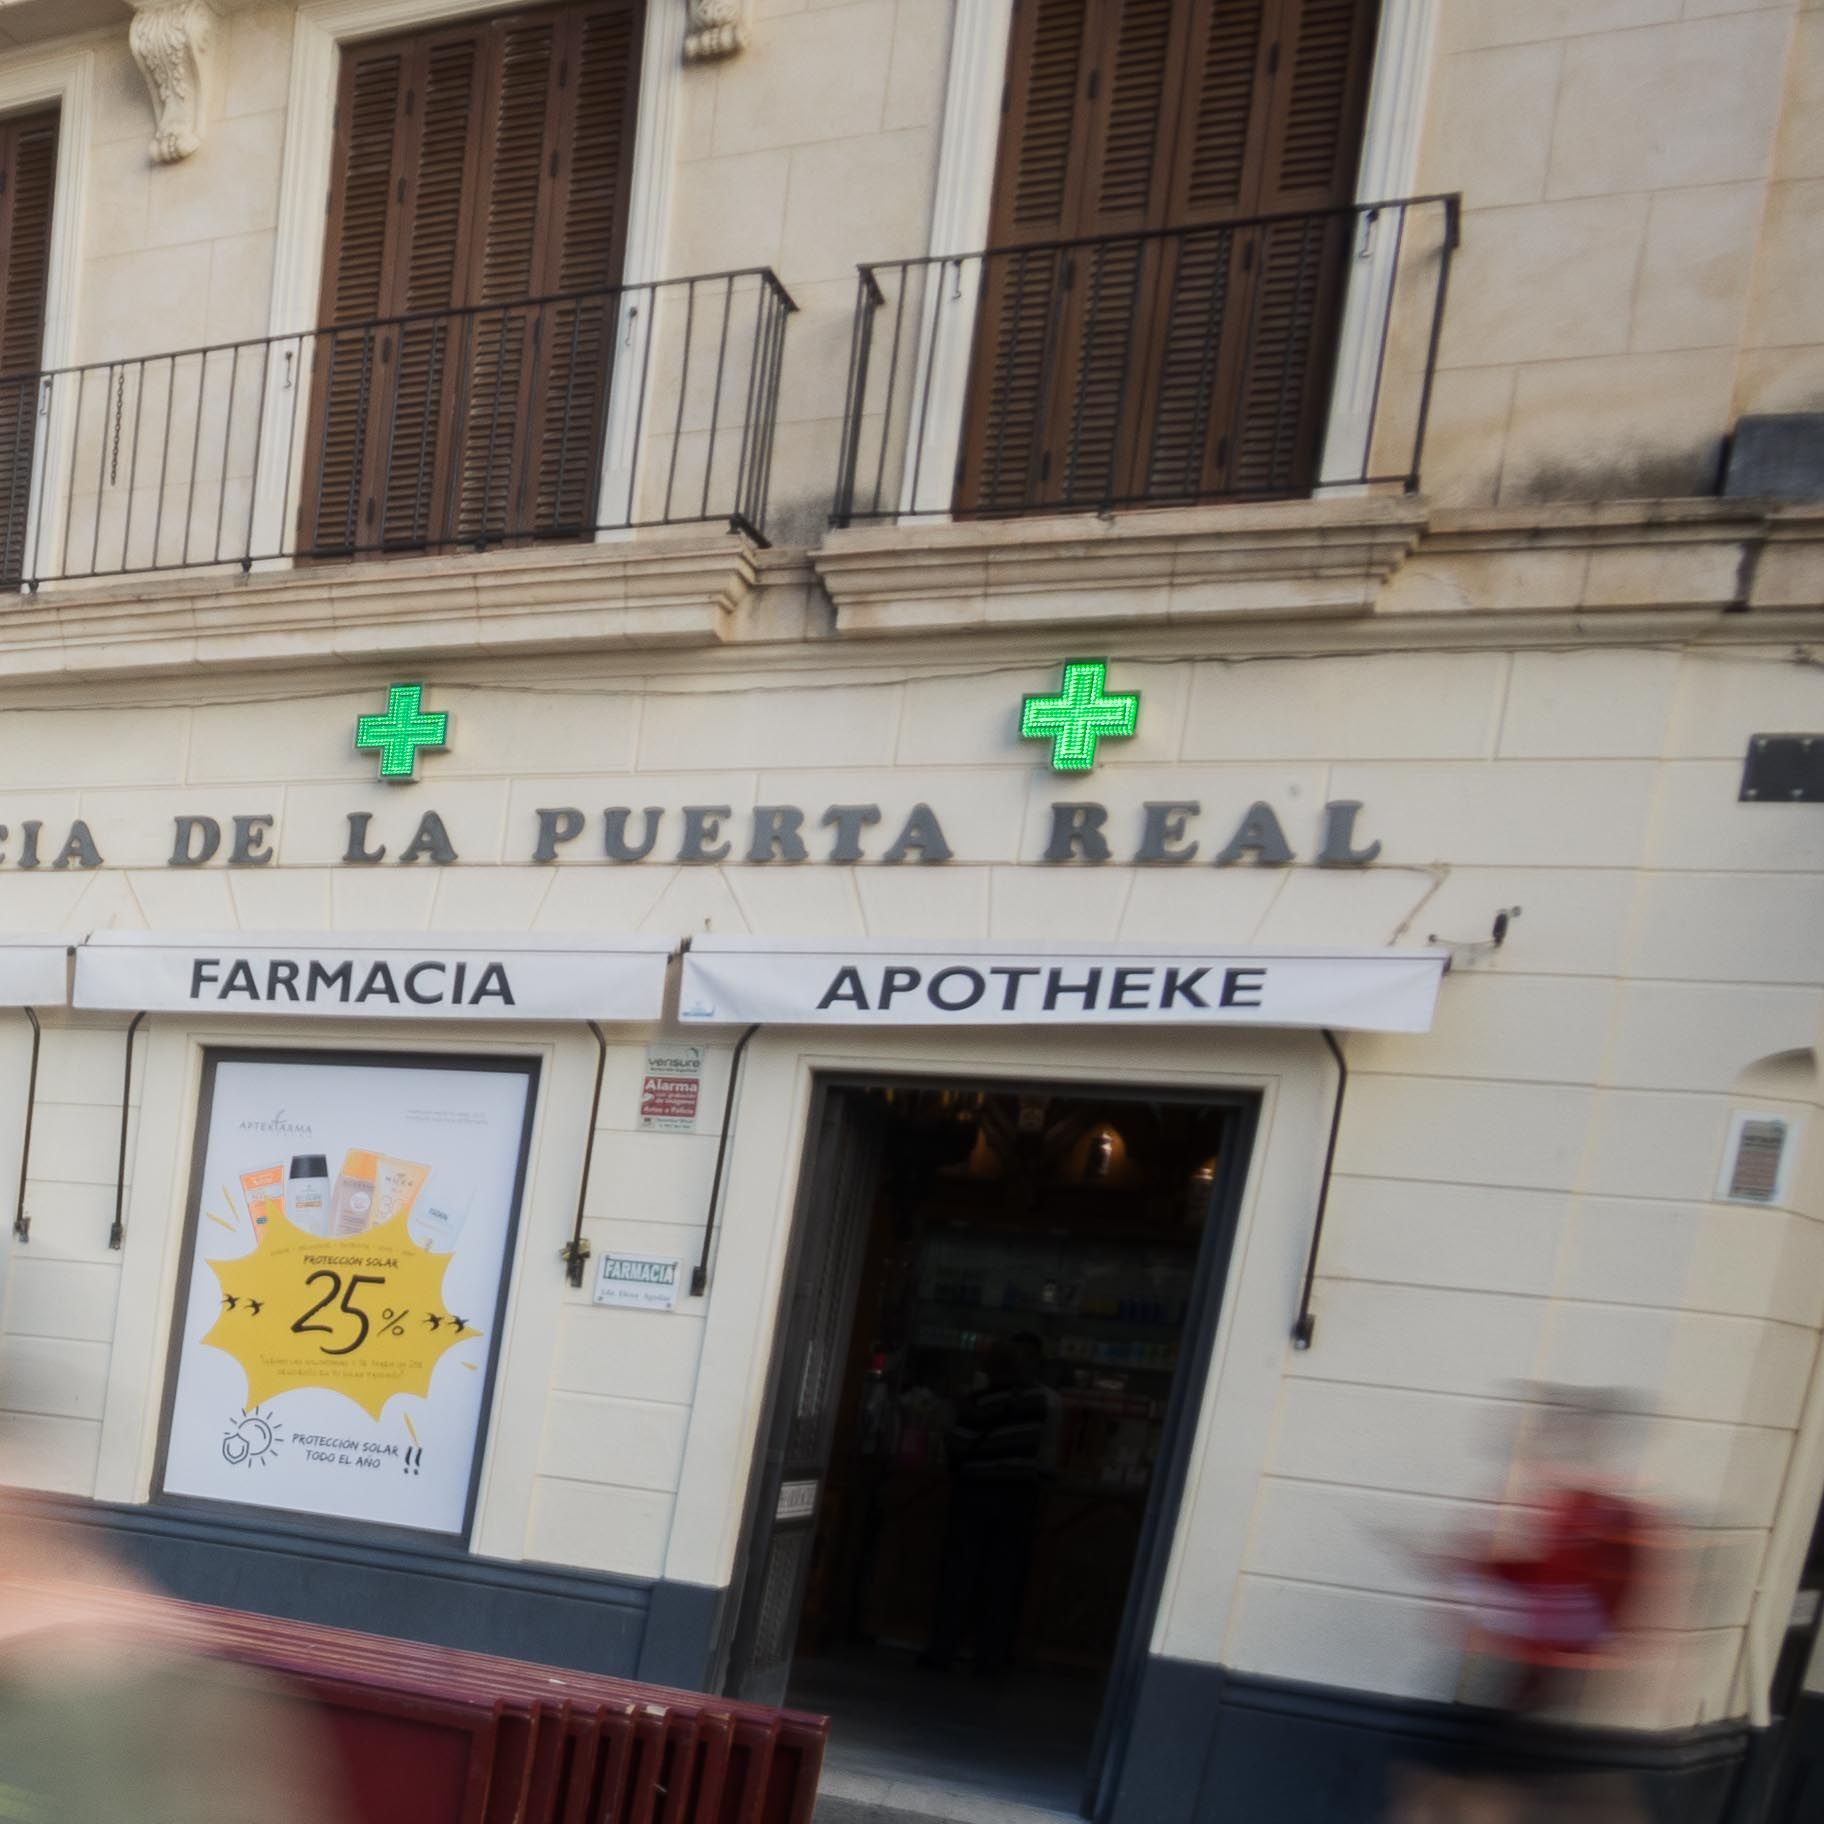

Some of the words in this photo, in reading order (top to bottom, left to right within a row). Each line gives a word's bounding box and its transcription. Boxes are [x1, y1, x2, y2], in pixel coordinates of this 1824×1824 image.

[168, 814, 275, 868] DE
[342, 809, 459, 865] LA
[531, 802, 955, 865] PUERTA
[1043, 800, 1382, 869] REAL
[189, 957, 517, 1006] FARMACIA
[815, 965, 1268, 1012] APOTHEKE
[645, 1079, 697, 1092] Alarma
[366, 1257, 400, 1269] SOLAR
[605, 1259, 673, 1284] FARMACIA
[291, 1433, 360, 1451] PROTECCIÓN
[362, 1442, 400, 1457] SOLAR
[305, 1450, 336, 1464] TODO
[338, 1453, 352, 1465] EL
[355, 1455, 382, 1469] AÑO
